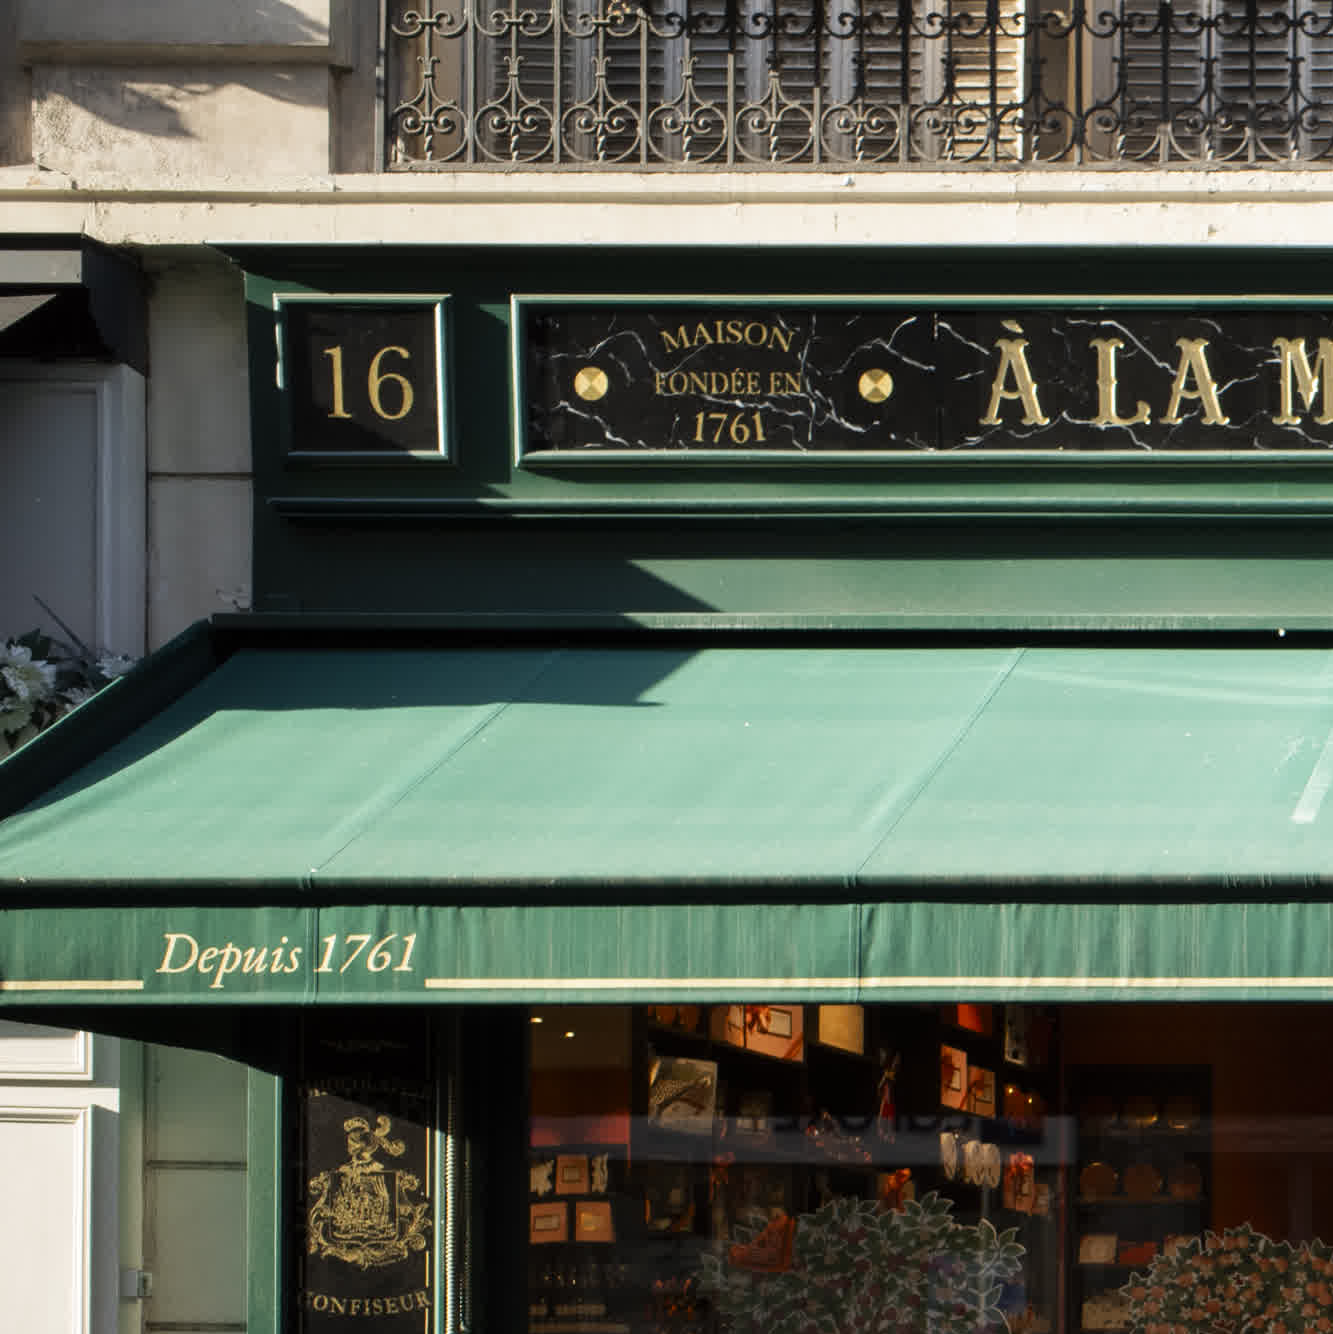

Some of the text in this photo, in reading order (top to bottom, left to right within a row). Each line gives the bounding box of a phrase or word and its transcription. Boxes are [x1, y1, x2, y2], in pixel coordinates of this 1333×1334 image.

[661, 319, 795, 354] MAISON
[322, 345, 414, 420] 16
[653, 368, 803, 396] FONDÉE EN
[979, 319, 1050, 427] À
[1089, 338, 1230, 427] LA
[692, 410, 768, 444] 1761
[155, 932, 417, 989] Depuis 1761
